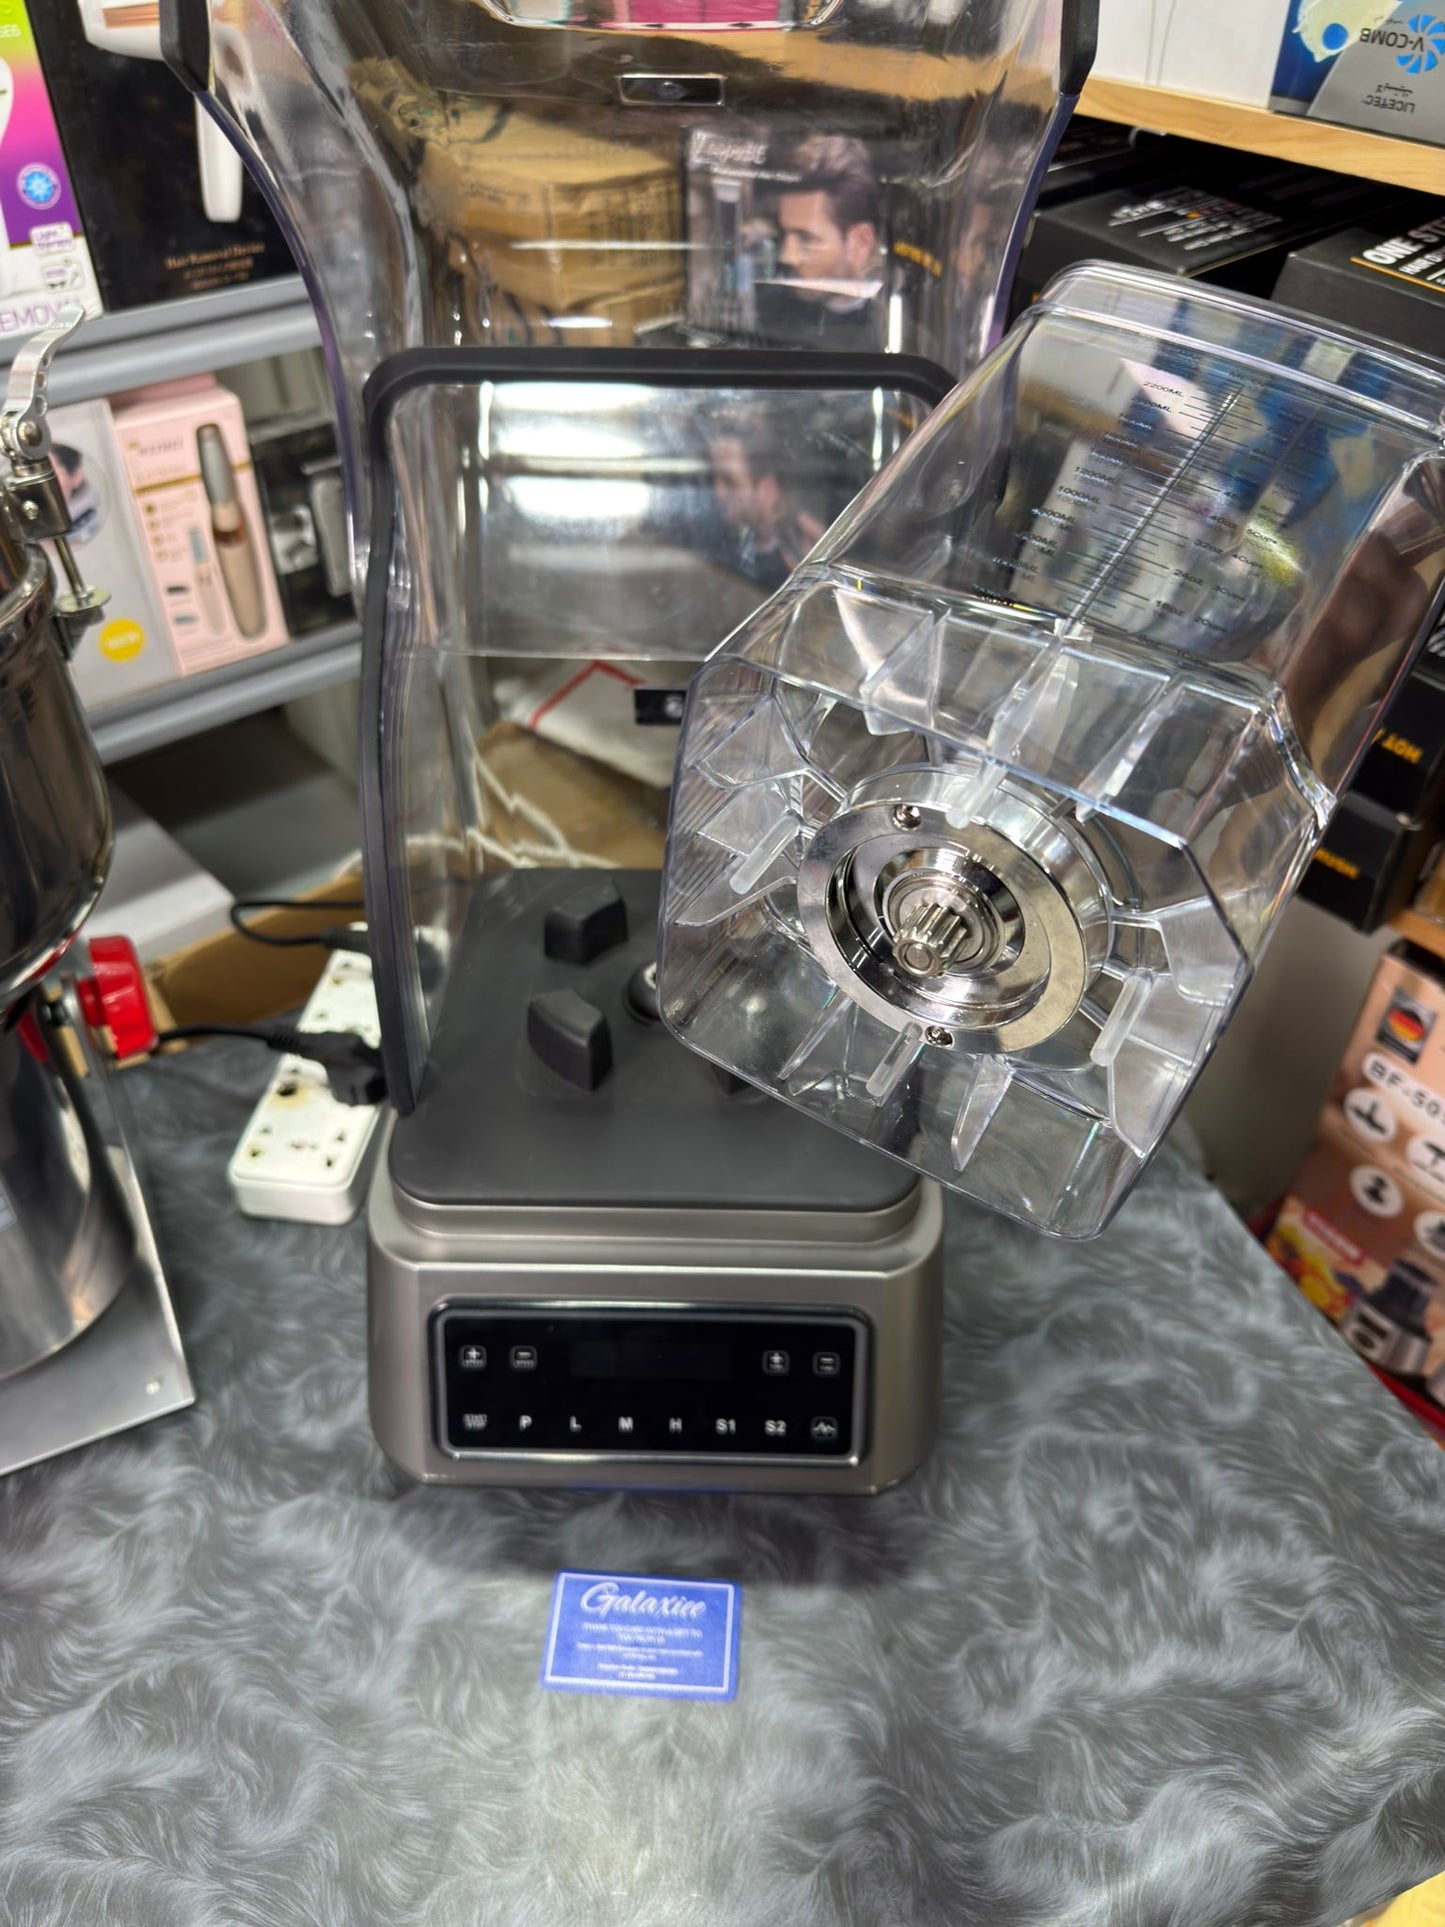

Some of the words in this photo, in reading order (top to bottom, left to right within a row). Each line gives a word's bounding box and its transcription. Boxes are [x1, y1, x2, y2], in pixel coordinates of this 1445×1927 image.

[1360, 28, 1424, 52] V-COMB
[1365, 94, 1416, 114] LICETEC
[1362, 237, 1424, 264] ONE
[1398, 258, 1436, 275] HAIR
[1143, 381, 1185, 397] 2200ML
[1058, 485, 1101, 504] 1000ML
[1246, 528, 1277, 545] 5Cups
[1231, 554, 1263, 569] 4Cups
[1173, 568, 1203, 585] 24oz
[1211, 584, 1246, 601] 3Cups
[519, 1414, 533, 1431] P
[569, 1415, 582, 1431] L
[618, 1416, 633, 1432] M
[669, 1417, 682, 1433] H
[715, 1418, 736, 1434] S1
[764, 1419, 786, 1436] S2
